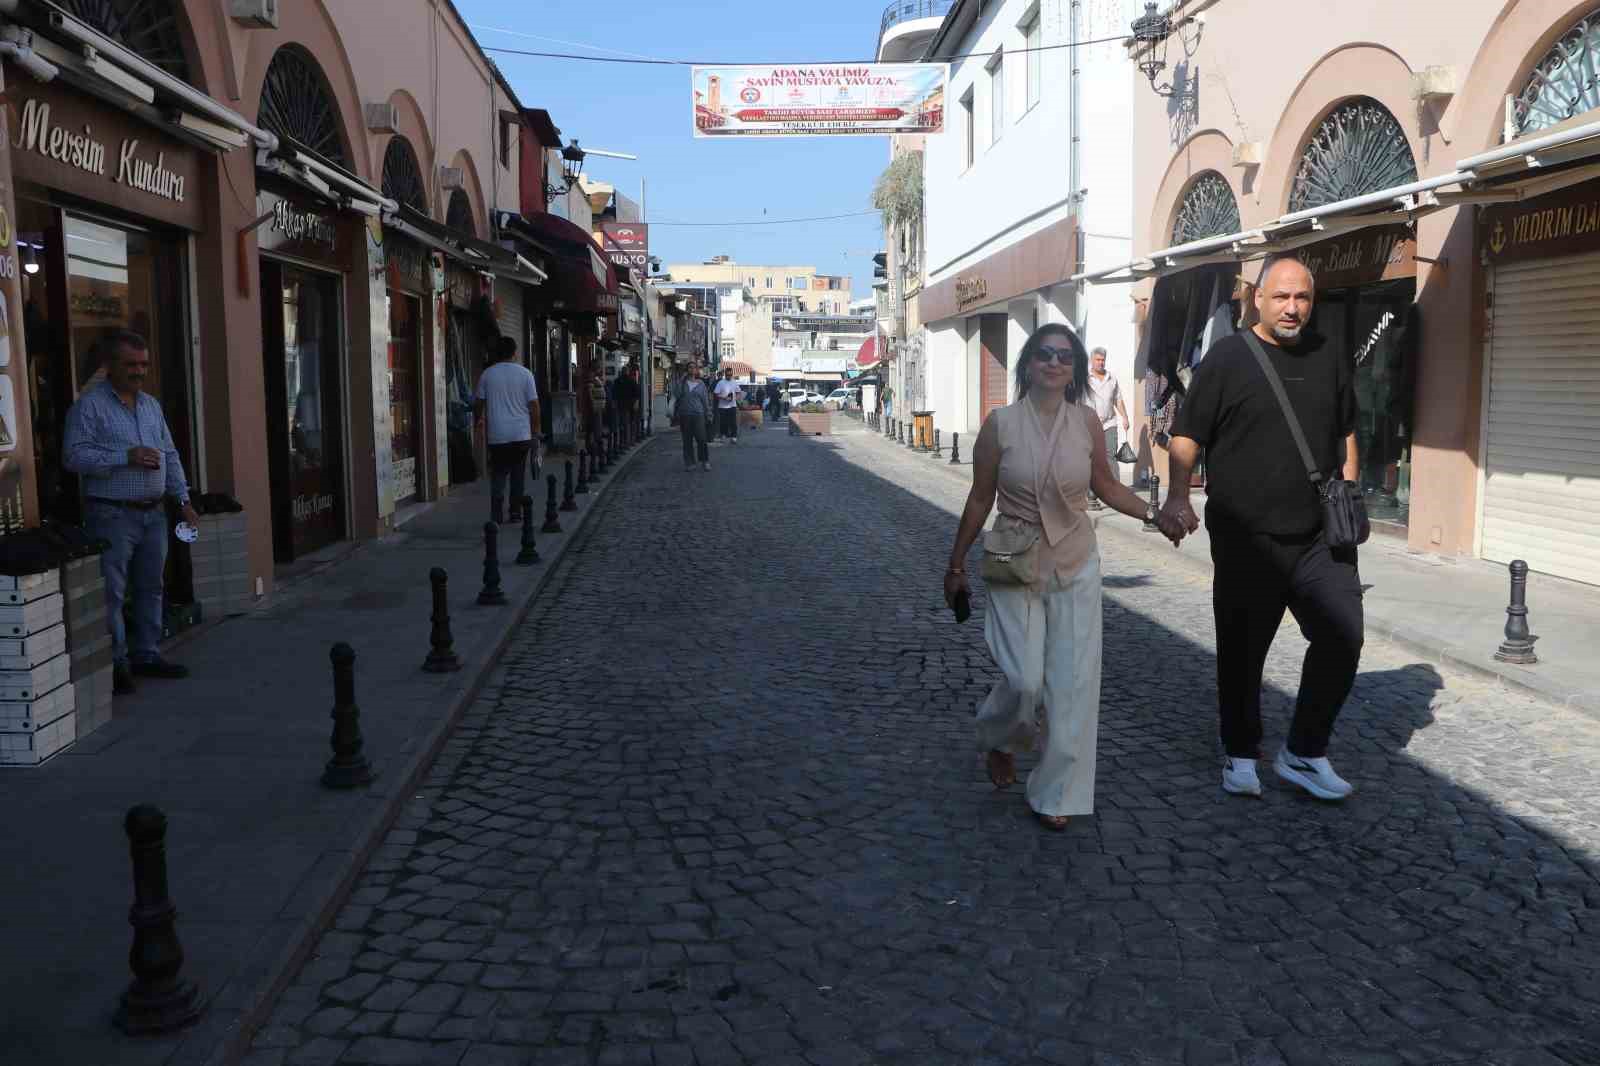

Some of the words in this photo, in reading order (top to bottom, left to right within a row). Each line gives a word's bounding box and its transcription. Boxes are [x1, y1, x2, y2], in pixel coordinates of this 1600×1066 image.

[771, 69, 816, 78] ADANA
[786, 77, 841, 86] MUSTAFA
[14, 99, 105, 175] Mevsim
[114, 138, 185, 203] Kundura
[1512, 206, 1573, 244] YILDIRIM
